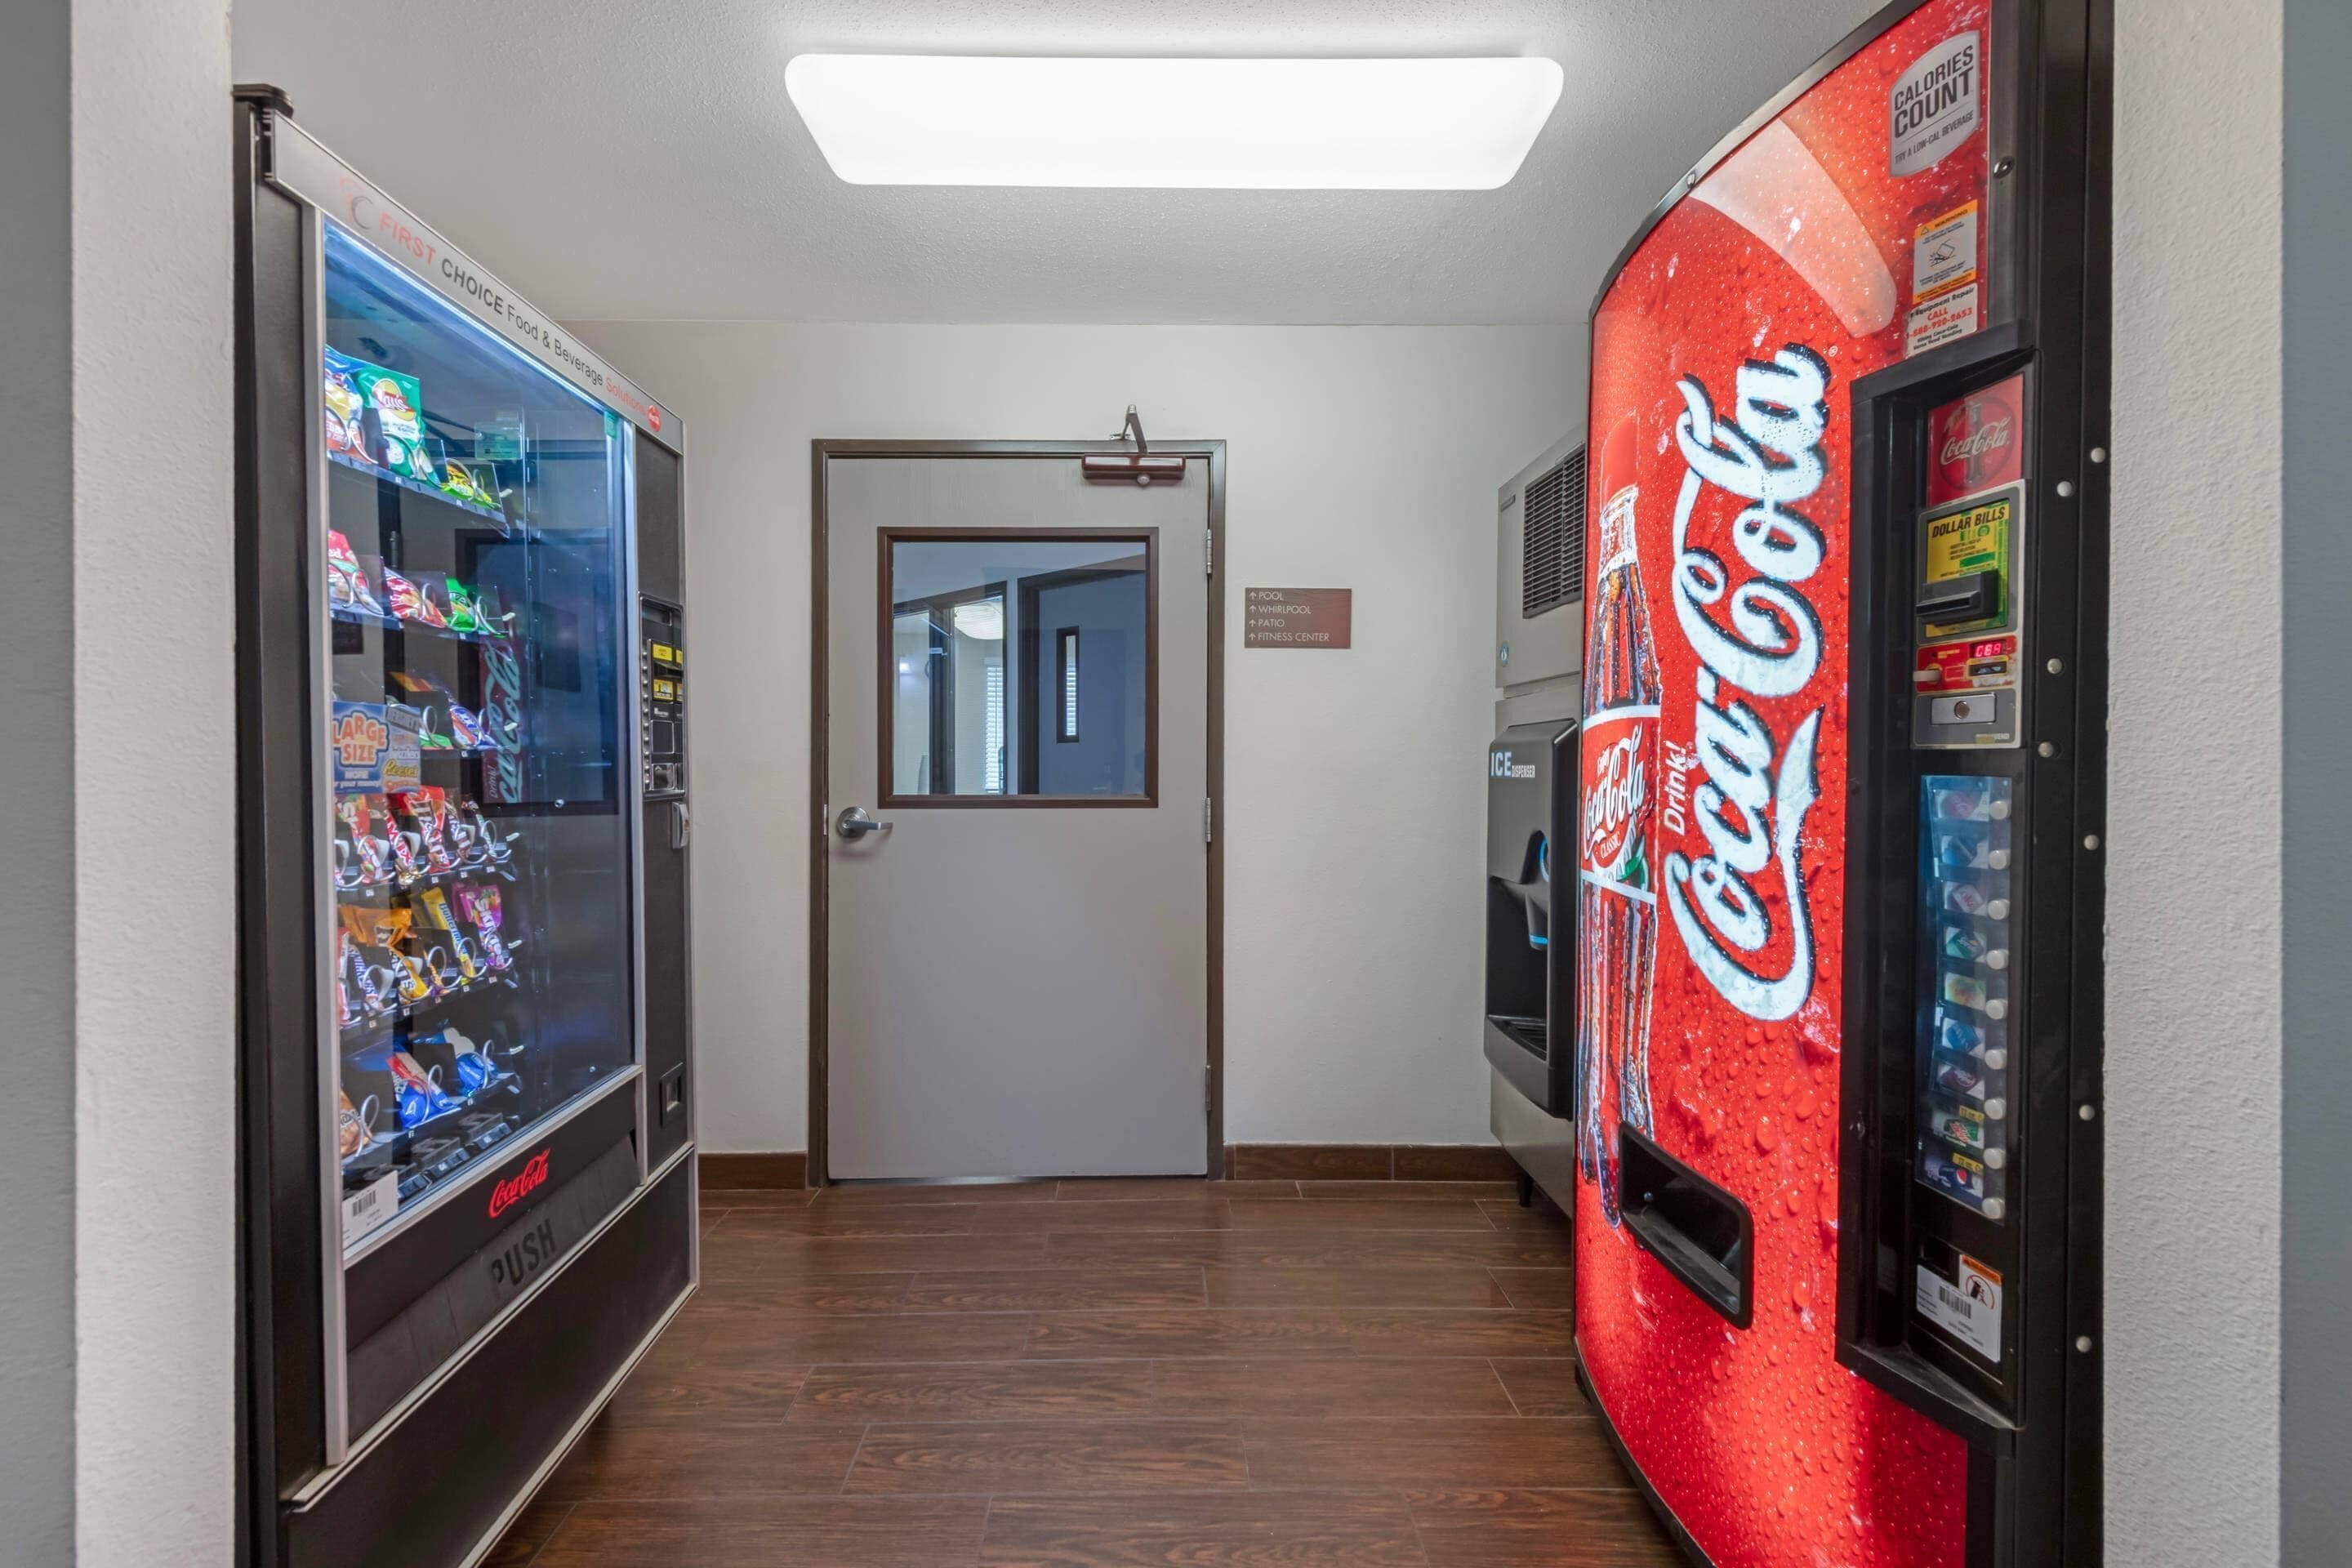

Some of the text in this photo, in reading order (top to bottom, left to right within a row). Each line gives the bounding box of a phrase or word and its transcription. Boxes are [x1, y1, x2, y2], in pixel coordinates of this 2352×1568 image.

[1895, 45, 1974, 111] CALORIES
[1895, 66, 1974, 139] COUNT
[1895, 110, 1974, 164] TRY A LOW-CAL BEVERAGE
[1952, 286, 1975, 302] Repair
[379, 212, 647, 416] FIRST CHOICE Food & Beverage Solutions
[1927, 306, 1949, 321] CALL
[1931, 506, 2006, 539] DOLLAR BILLS
[1258, 590, 1284, 601] POOL
[1258, 605, 1312, 614] WHIRLPOOL
[1258, 618, 1285, 628] PATIO
[1258, 632, 1330, 642] FITNESS CENTER
[332, 714, 386, 747] LARGE
[342, 743, 376, 763] SIZE
[1490, 751, 1535, 778] ICE DISPENSER
[1664, 741, 1687, 836] Drink!
[1600, 831, 1621, 859] CLASSIC
[490, 1218, 556, 1298] PUSH
